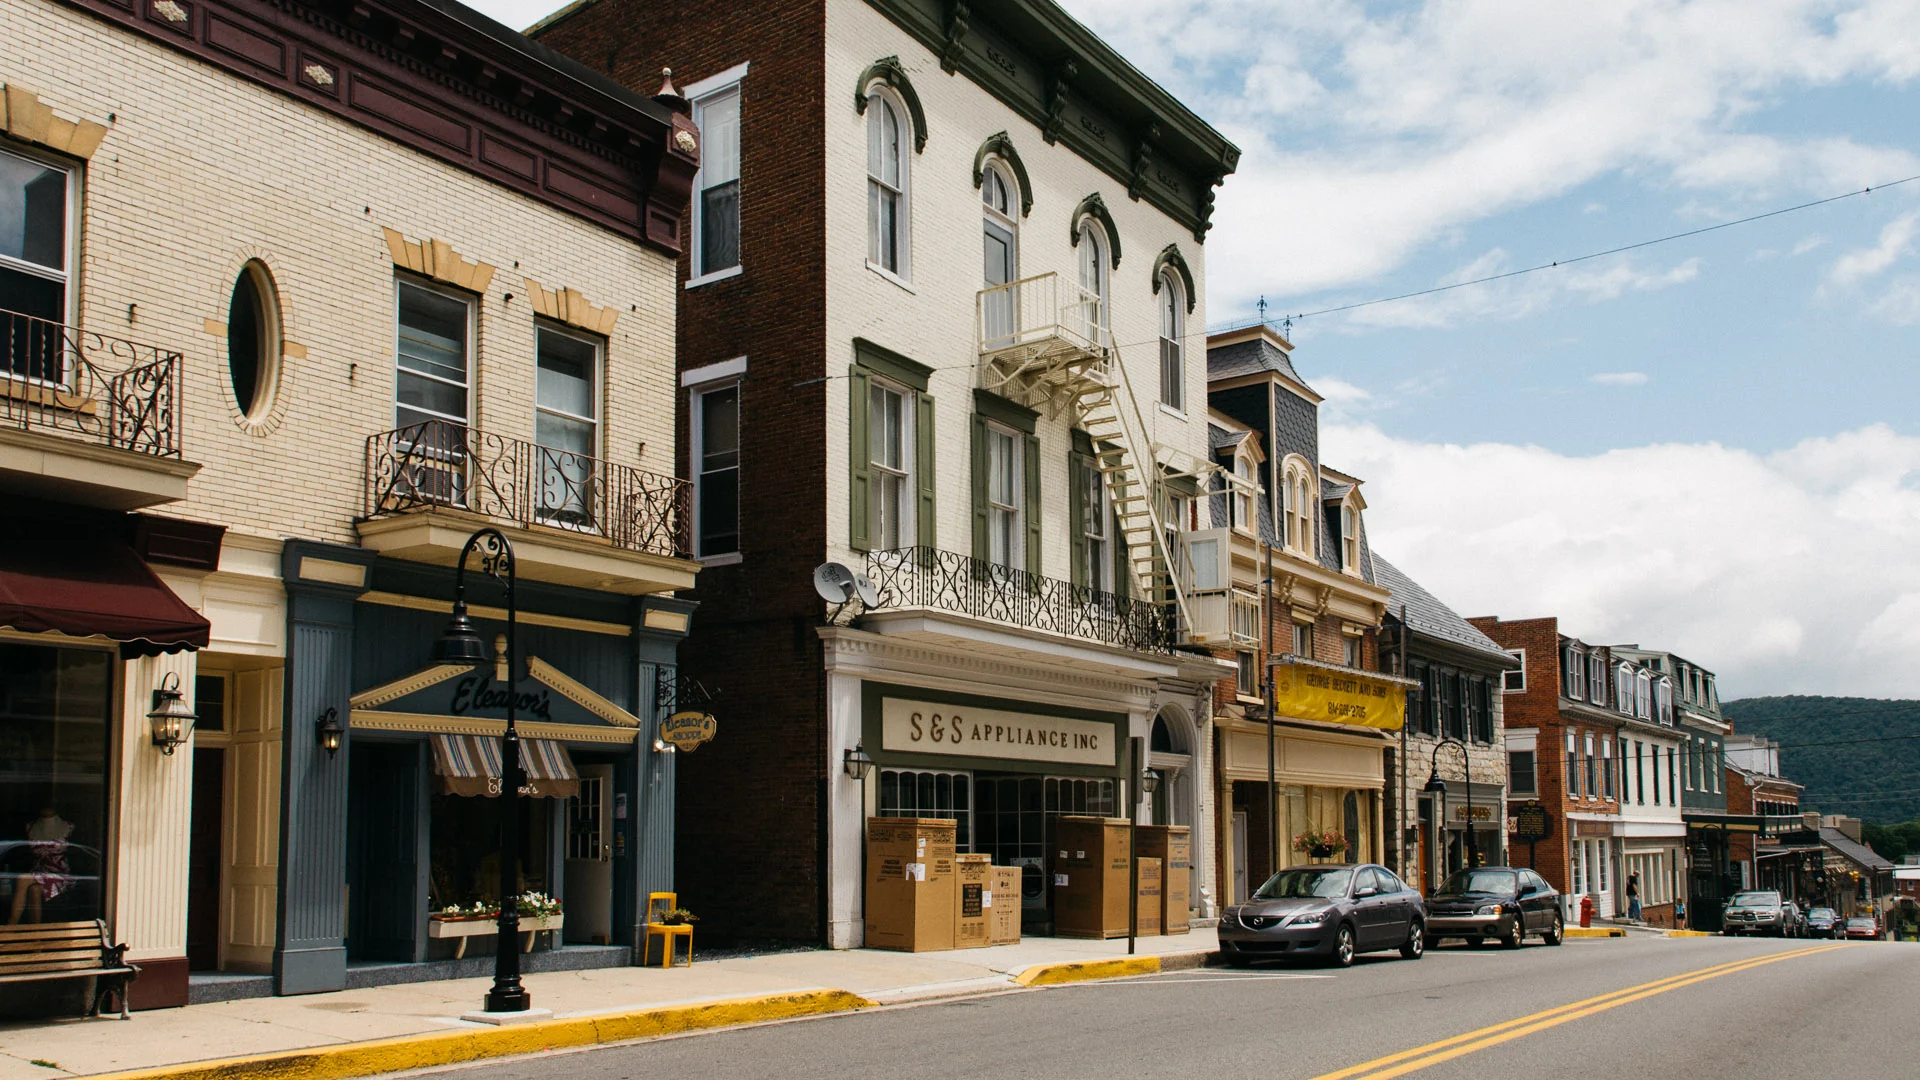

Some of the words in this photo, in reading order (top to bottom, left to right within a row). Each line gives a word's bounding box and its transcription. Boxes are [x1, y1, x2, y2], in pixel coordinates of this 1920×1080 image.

[450, 675, 552, 721] Eleanor's
[1306, 673, 1330, 689] GEORGE
[1358, 682, 1371, 696] AND
[1372, 684, 1387, 698] SONS
[971, 724, 1068, 748] APPLIANCE
[1073, 734, 1098, 750] INC
[487, 777, 539, 794] Elnor's
